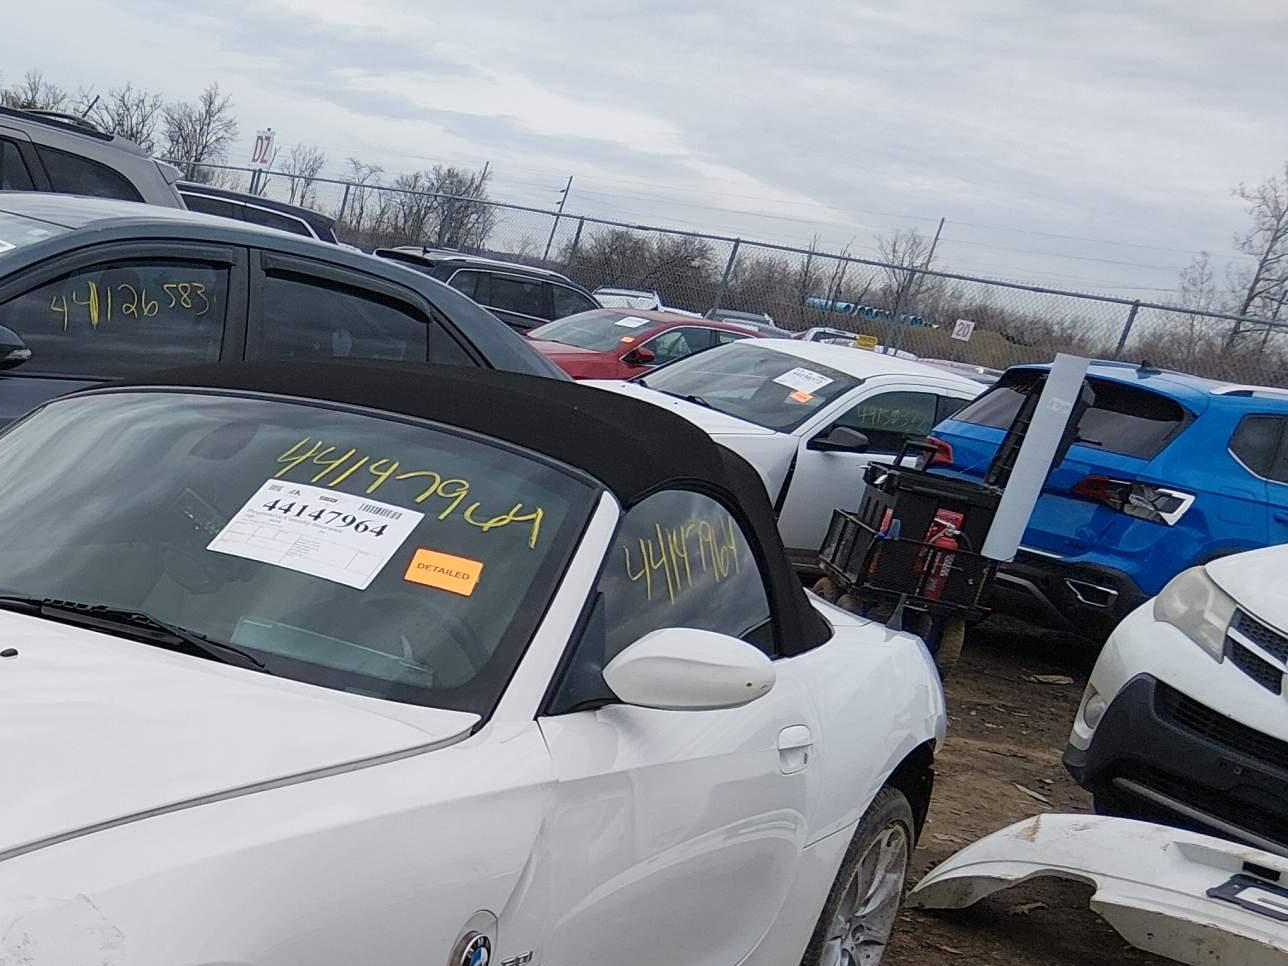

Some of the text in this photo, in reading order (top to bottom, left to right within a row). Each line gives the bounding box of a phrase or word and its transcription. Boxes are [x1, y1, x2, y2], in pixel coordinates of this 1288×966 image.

[956, 321, 971, 338] 20
[274, 436, 544, 549] 44147964
[263, 499, 389, 537] 44147964
[417, 561, 471, 581] DETAILED
